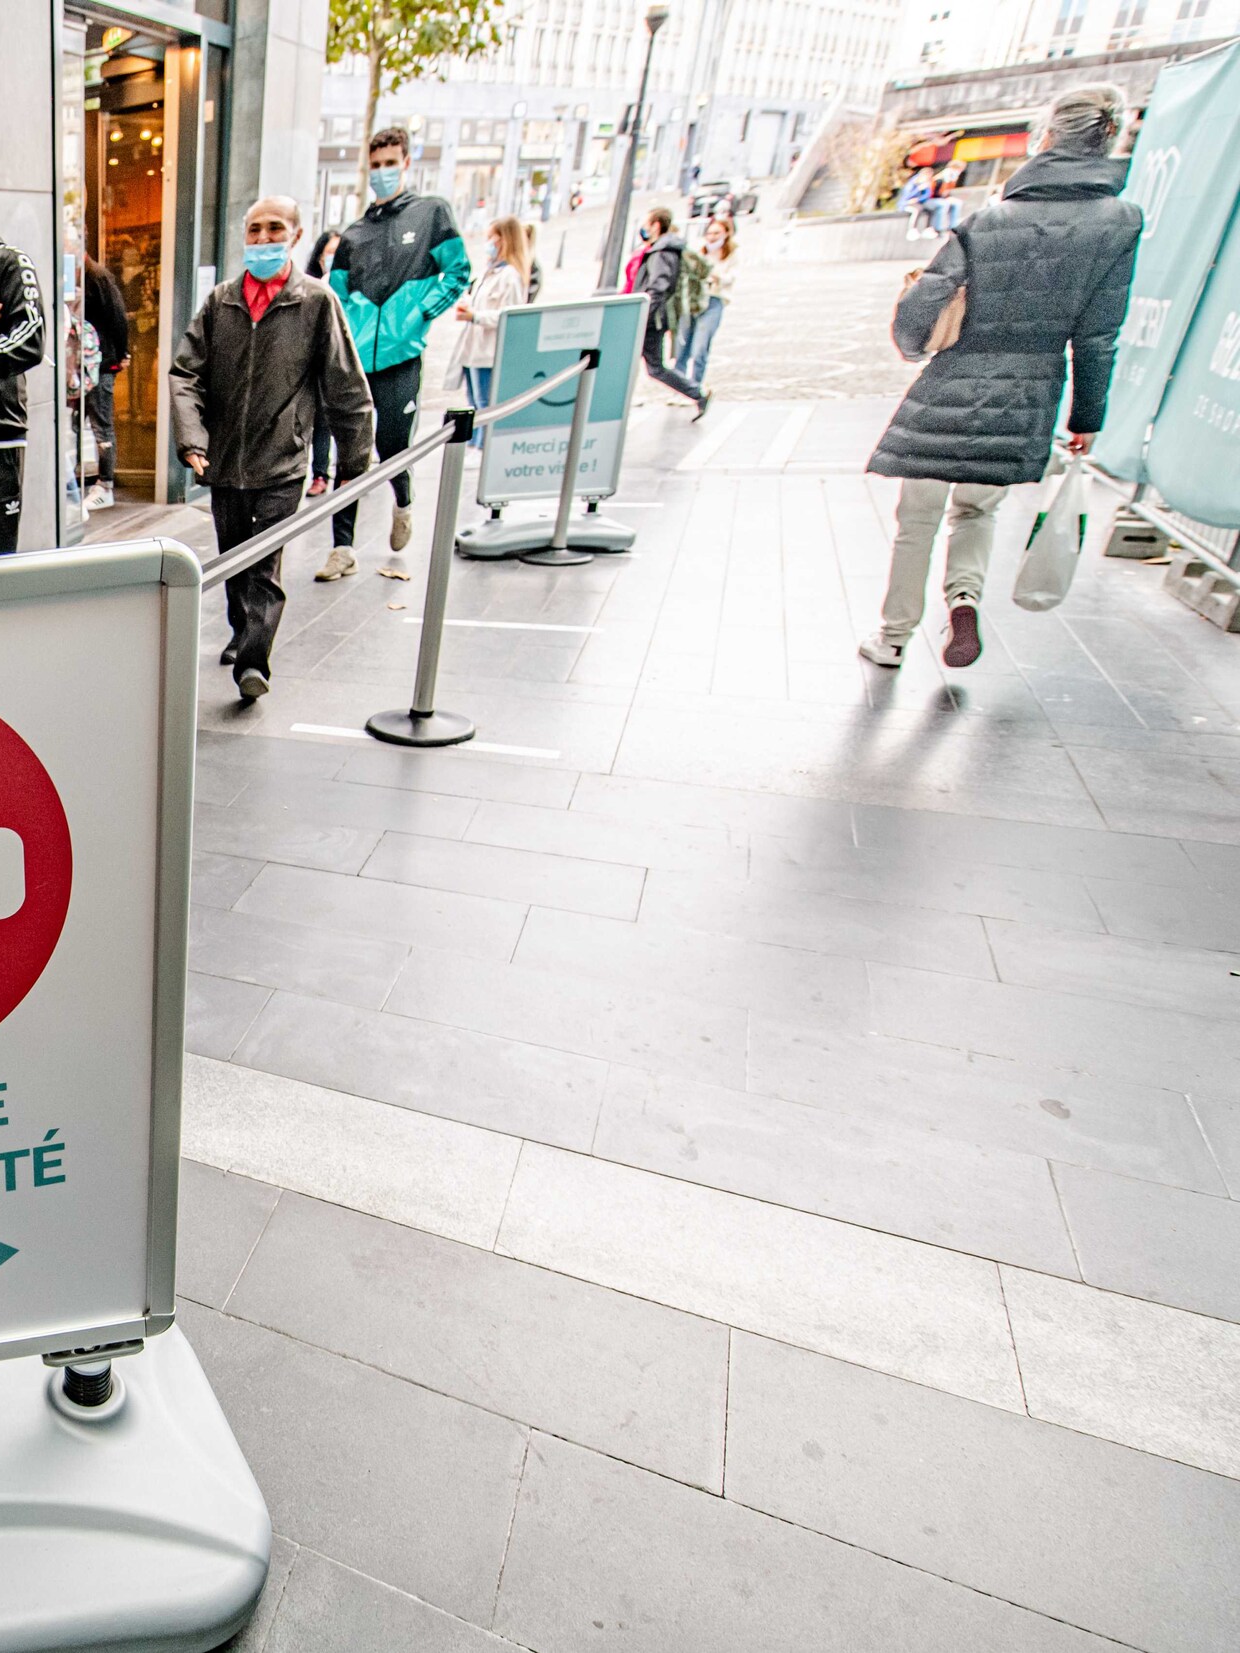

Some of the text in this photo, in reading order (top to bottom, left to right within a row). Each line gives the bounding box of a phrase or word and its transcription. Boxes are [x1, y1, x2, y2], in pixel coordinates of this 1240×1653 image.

[512, 437, 597, 455] Merci pur
[504, 464, 545, 478] votre
[549, 460, 589, 475] vise
